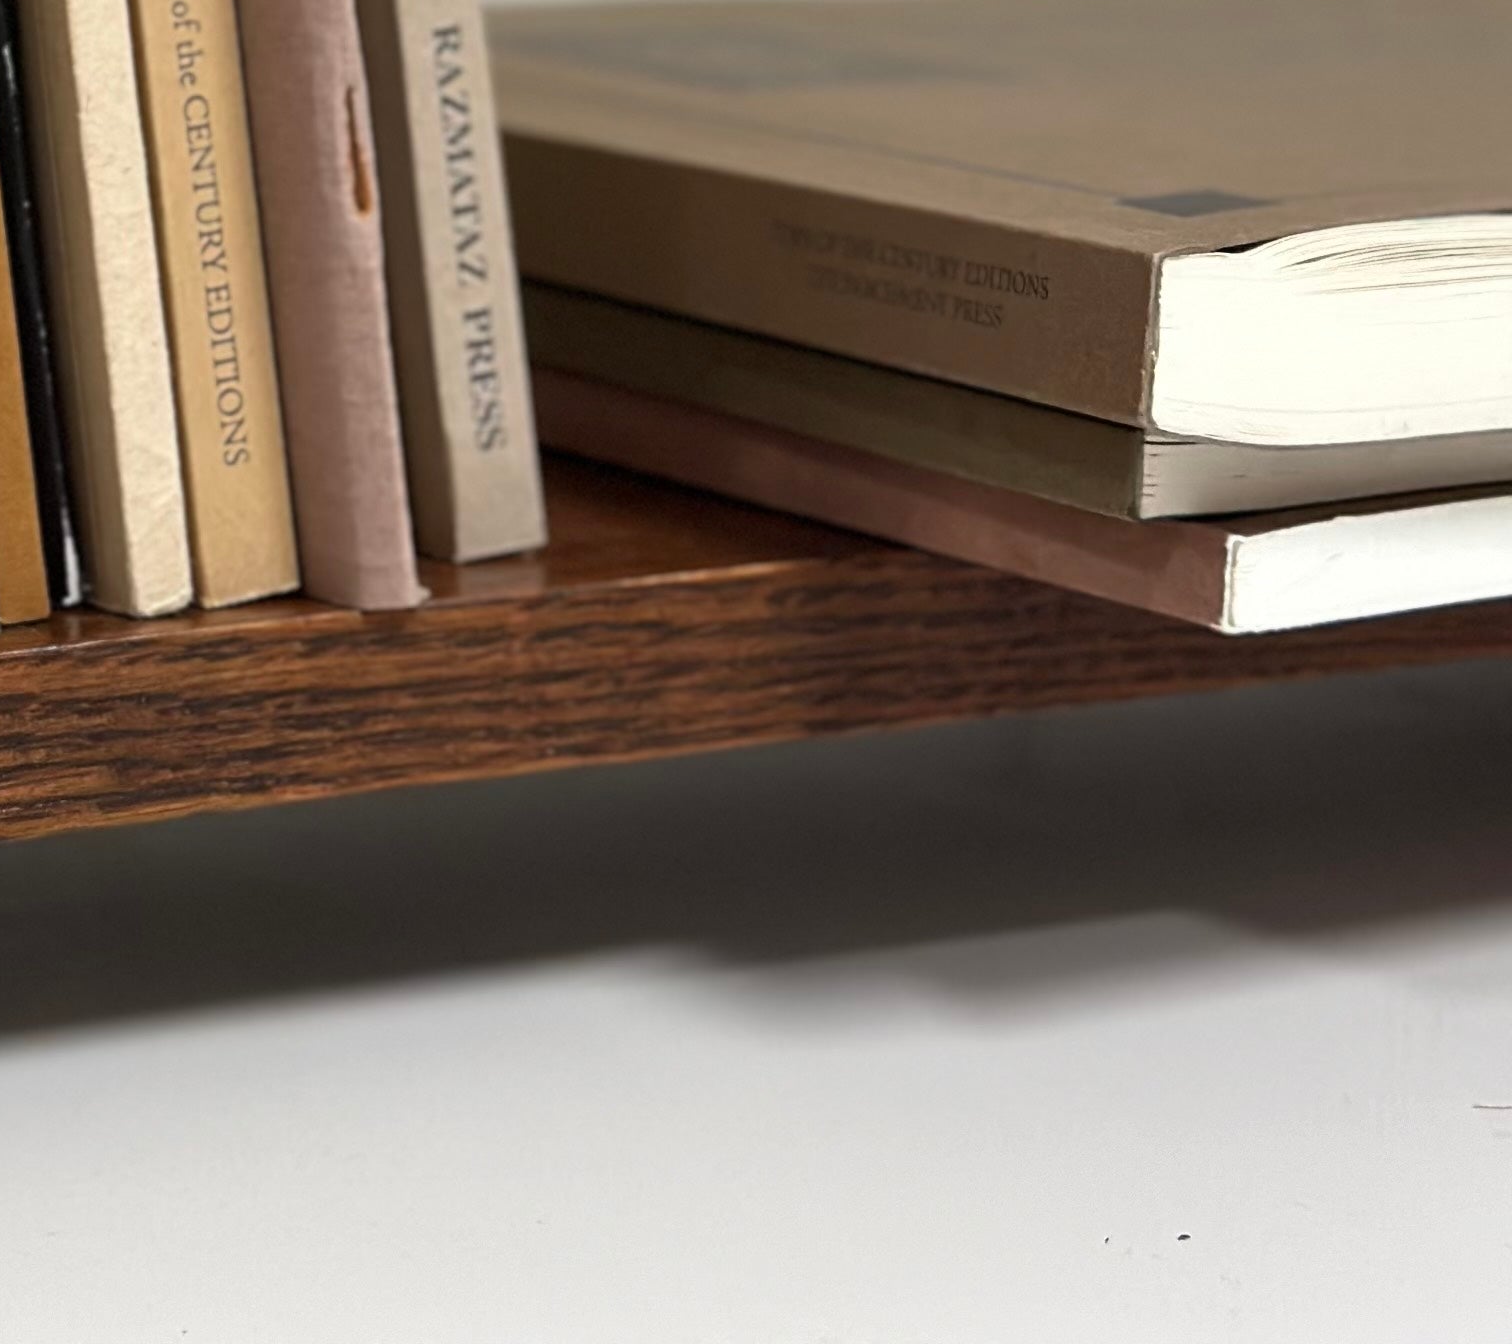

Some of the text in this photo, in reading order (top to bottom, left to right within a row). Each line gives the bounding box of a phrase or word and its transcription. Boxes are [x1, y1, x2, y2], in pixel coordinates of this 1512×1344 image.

[173, 1, 202, 32] of
[176, 36, 200, 87] the
[183, 94, 228, 273] CENTURY
[432, 23, 507, 452] RAZMATAZ PRESS
[963, 260, 1049, 300] EDITIONS
[950, 291, 1004, 329] PRESS
[205, 285, 250, 466] EDITIONS
